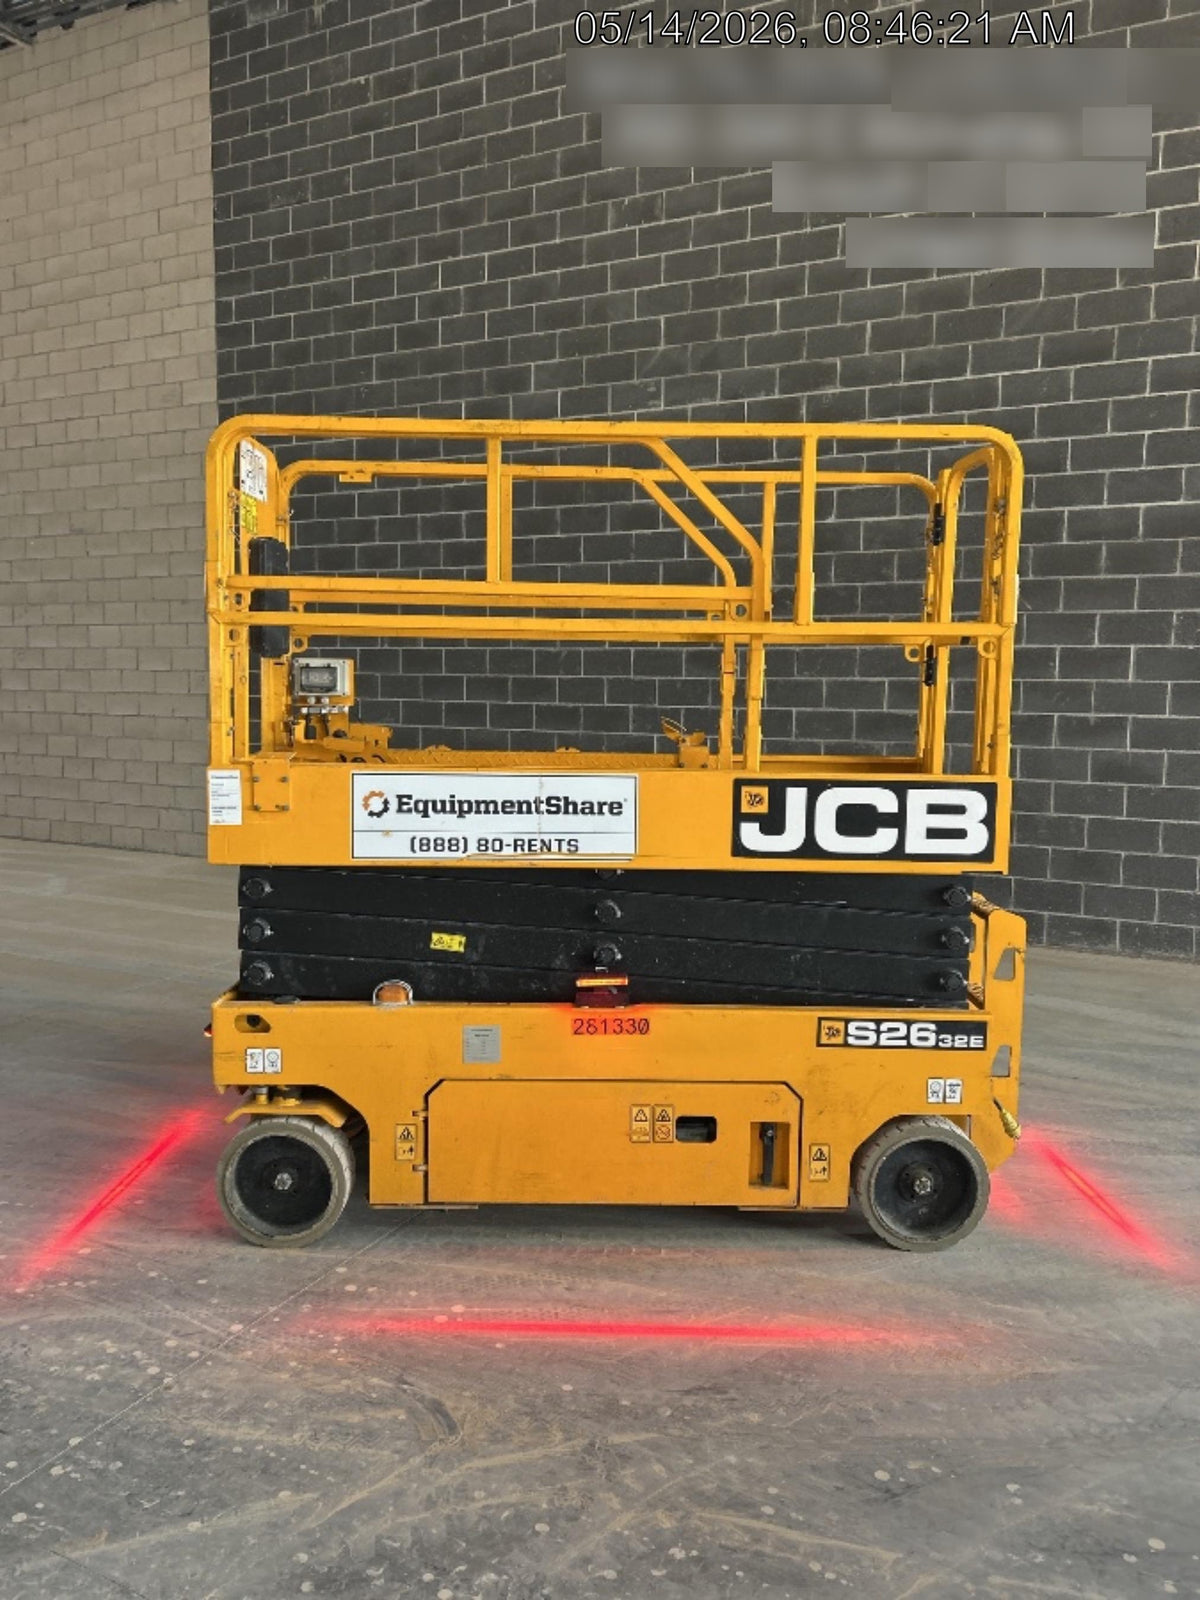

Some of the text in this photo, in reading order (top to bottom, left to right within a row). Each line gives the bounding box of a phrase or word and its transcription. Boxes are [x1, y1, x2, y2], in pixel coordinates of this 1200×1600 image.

[396, 794, 624, 818] EquipmentShare
[740, 786, 989, 854] JCB
[410, 836, 580, 854] (888) 80-RENTS
